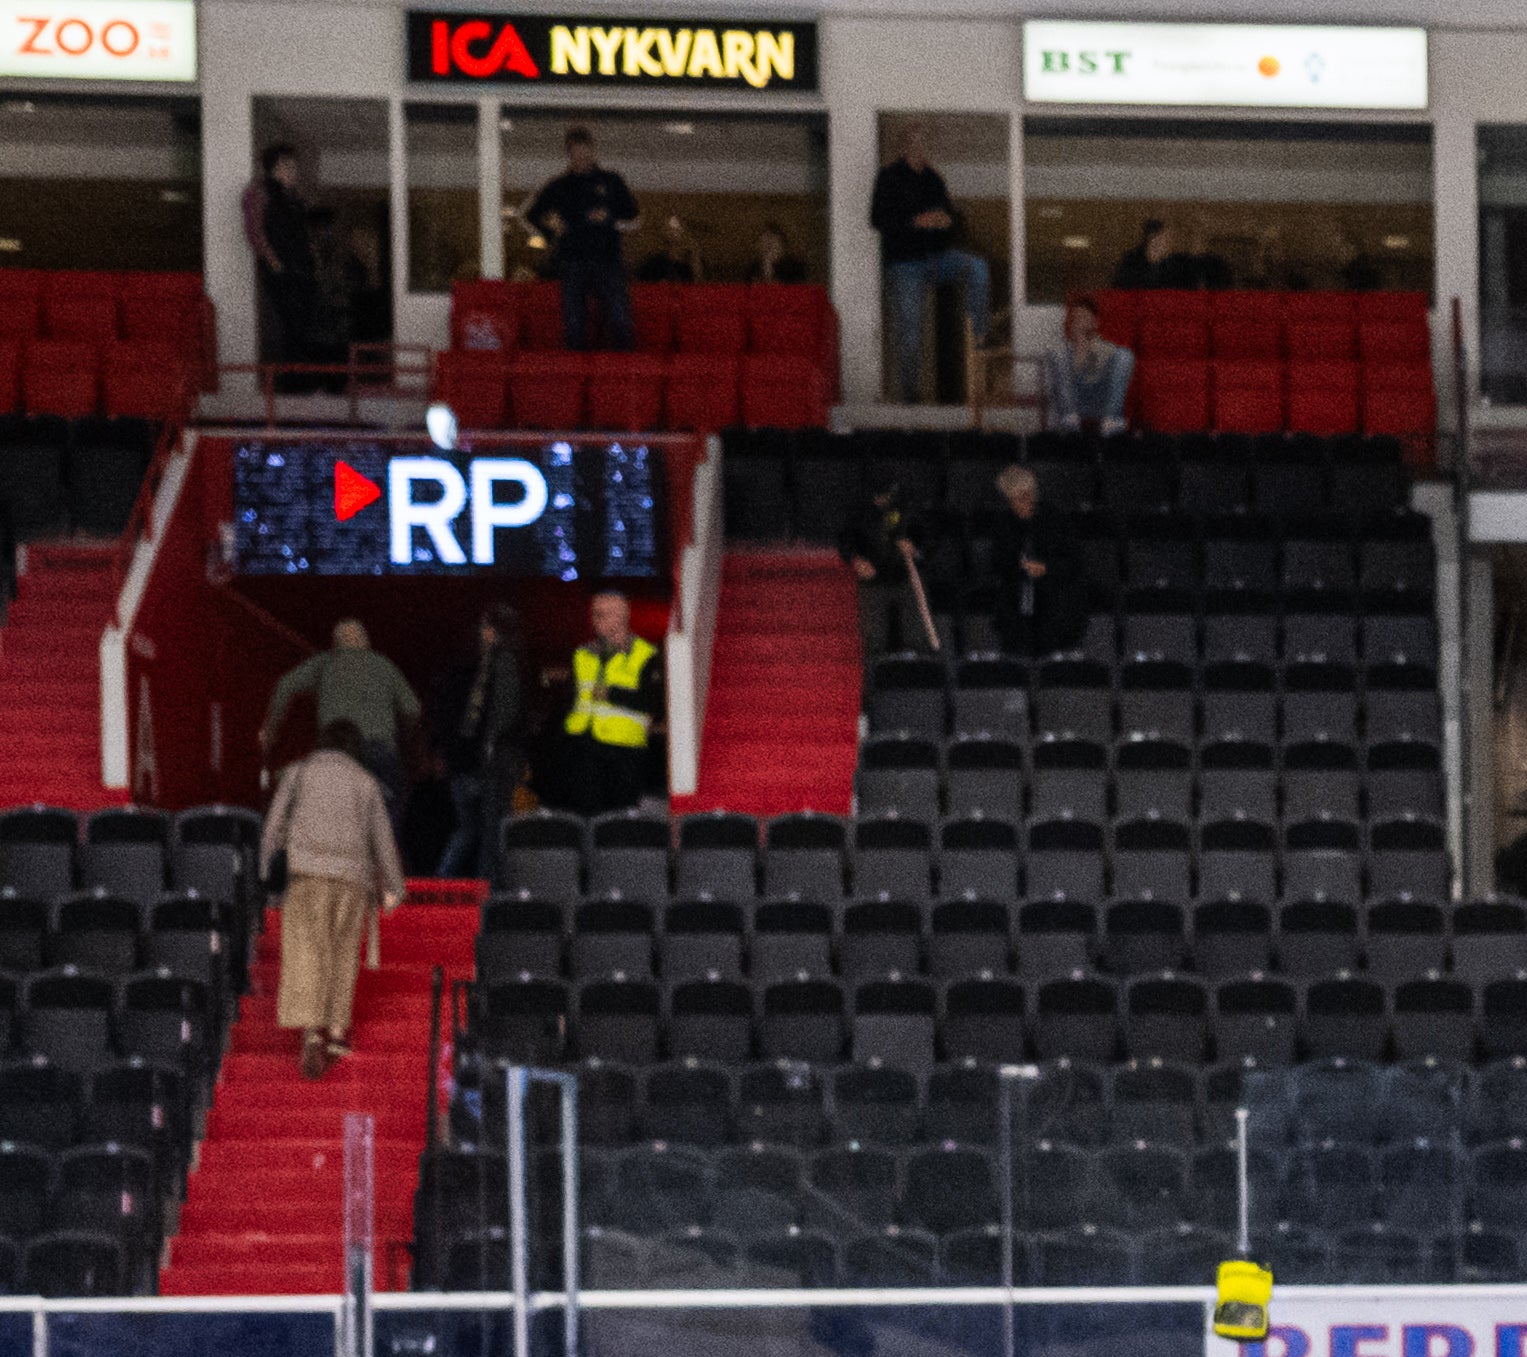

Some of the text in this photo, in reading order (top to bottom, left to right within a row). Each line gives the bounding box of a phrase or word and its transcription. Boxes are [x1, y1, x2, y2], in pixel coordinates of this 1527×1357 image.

[16, 16, 140, 58] ZOO
[430, 20, 796, 88] ICA NYKVARN
[1040, 50, 1133, 75] BST
[388, 458, 548, 566] RP
